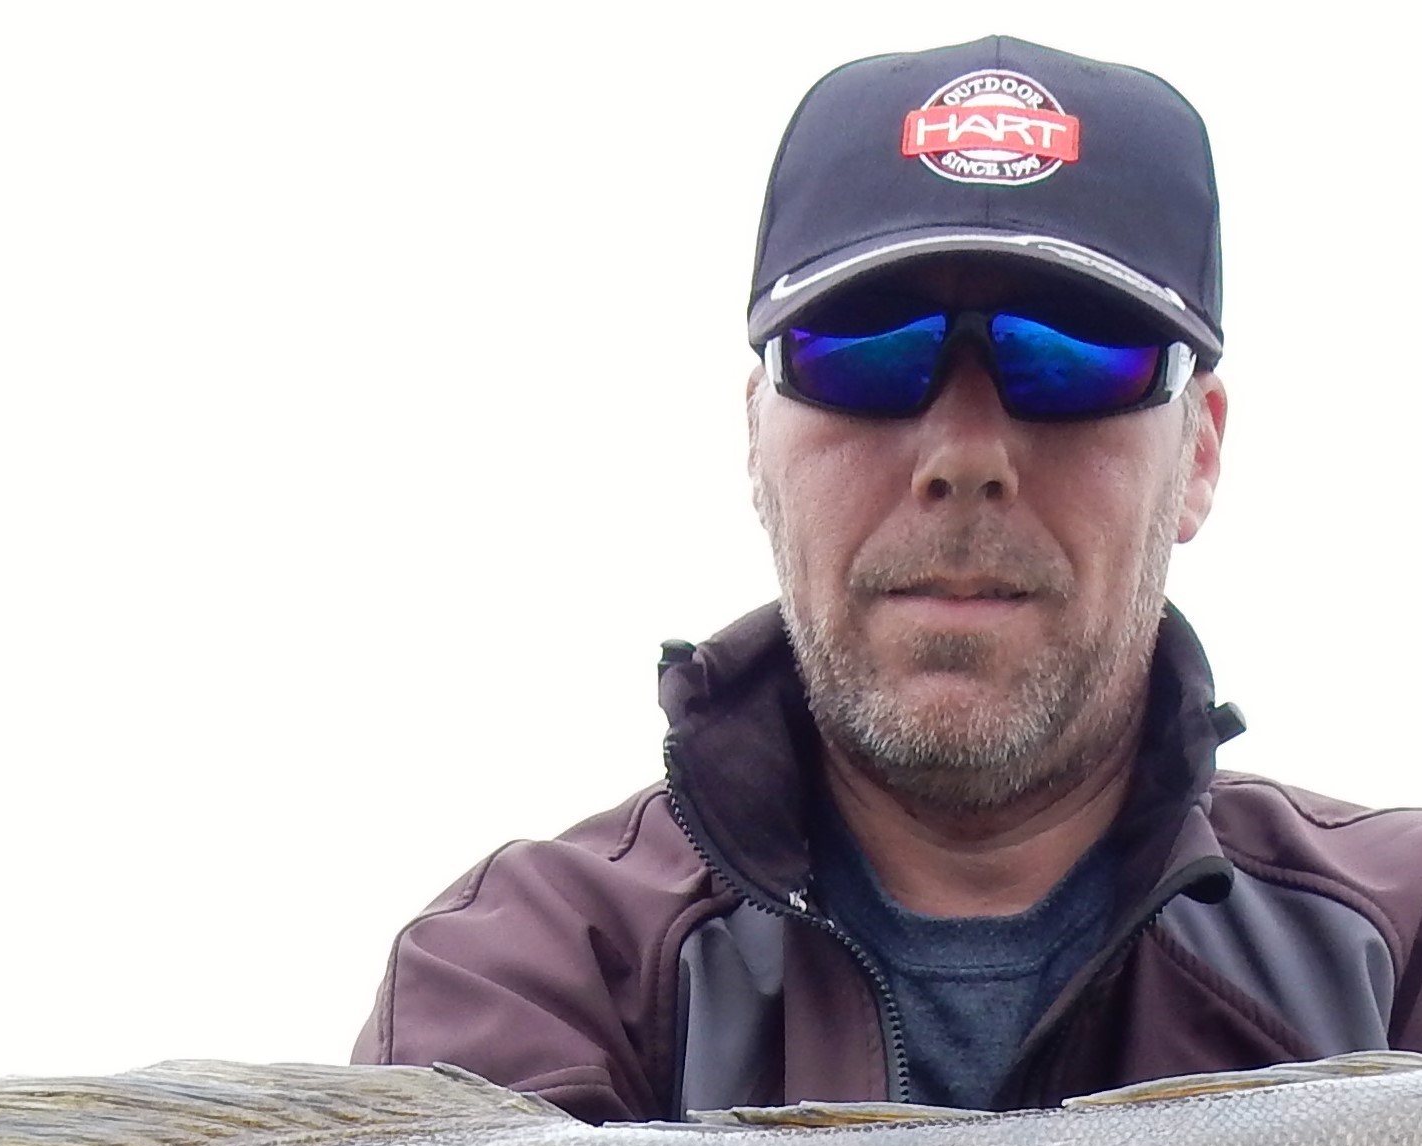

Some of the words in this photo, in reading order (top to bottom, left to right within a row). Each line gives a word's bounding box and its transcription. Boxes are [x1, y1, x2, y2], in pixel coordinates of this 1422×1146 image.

[943, 77, 1044, 110] OUTDOOR
[916, 113, 1067, 149] HART
[941, 151, 1000, 176] SINCE
